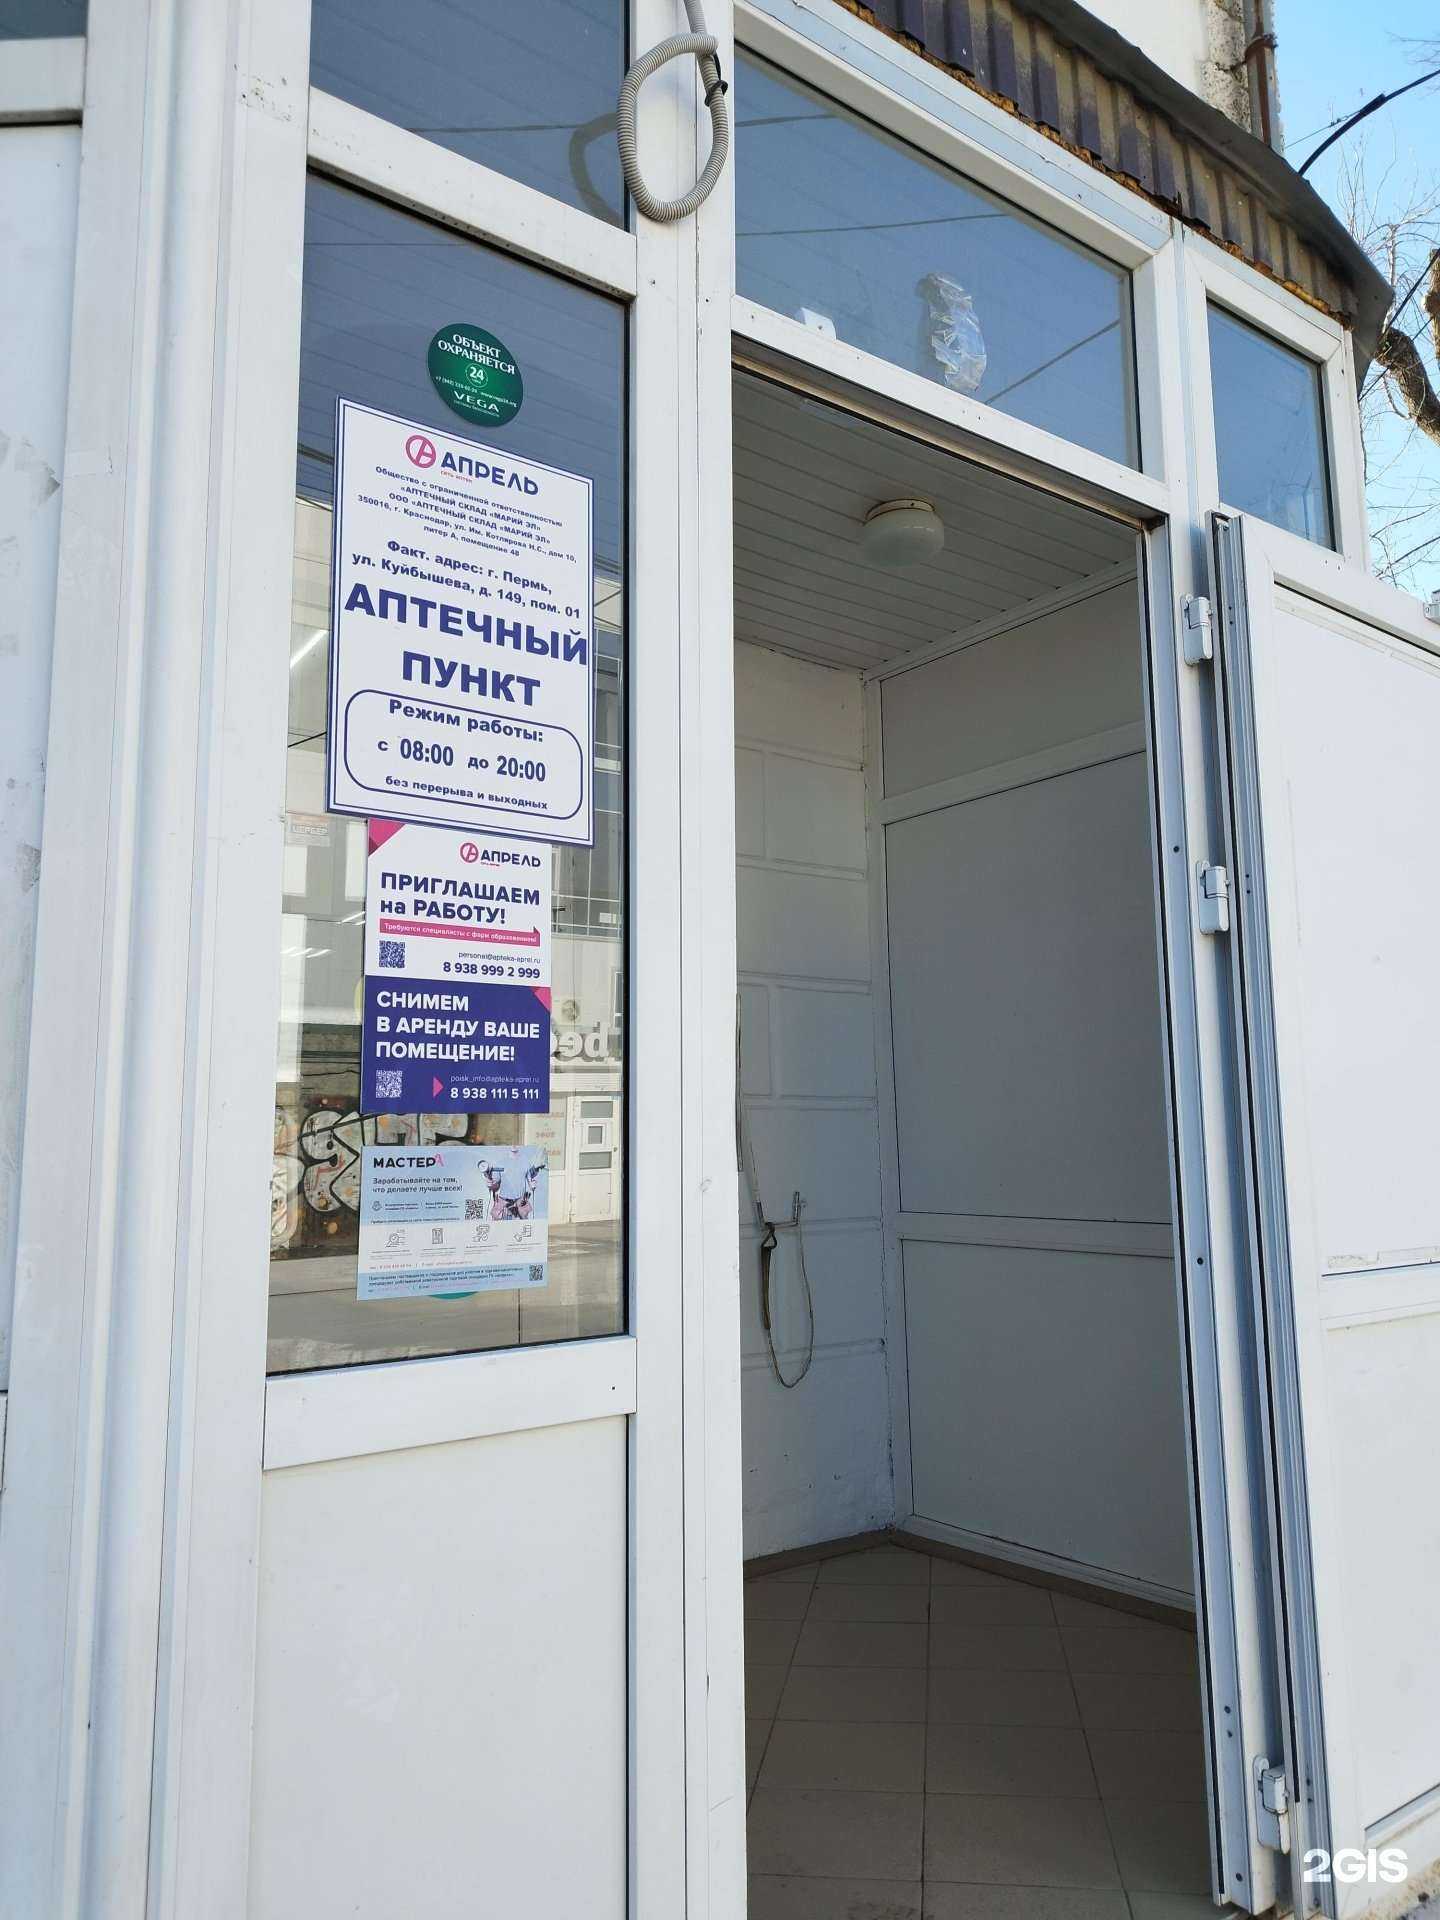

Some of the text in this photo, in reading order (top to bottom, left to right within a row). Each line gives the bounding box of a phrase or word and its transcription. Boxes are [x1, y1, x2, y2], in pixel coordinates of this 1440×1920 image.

[437, 340, 515, 375] ОХРАНЯЕТСЯ
[452, 334, 501, 358] ОБЪЕКТ
[469, 366, 484, 381] 24
[454, 391, 500, 413] VEGA
[441, 452, 539, 495] АПРЕЛЬ
[375, 466, 419, 485] Общество
[429, 483, 489, 505] ограниченной
[492, 500, 563, 527] ответственностью
[401, 485, 455, 506] «АПТЕЧНЫЙ
[458, 500, 487, 516] СКЛАД
[489, 509, 523, 525] «МАРИЙ
[357, 495, 392, 512] 350016,
[403, 507, 452, 528] Краснодар,
[454, 521, 466, 532] ул.
[389, 492, 409, 504] ООО
[411, 497, 466, 519] «АПТЕЧНЫЙ
[469, 514, 497, 530] СКЛАД
[499, 523, 533, 539] «МАРИЙ
[461, 534, 507, 554] помещение
[387, 540, 552, 595] Факт. адрес: г. Пермь,
[351, 552, 580, 618] ул. Куйбышева, д. 149, пом. 01
[344, 582, 587, 665] АПТЕЧНЫЙ
[402, 651, 541, 706] ПУНКТ
[389, 699, 543, 742] Режим работы:
[378, 738, 546, 782] с 08:00 до 20:00
[385, 775, 548, 809] без перерыва и выходных
[481, 849, 541, 868] АПРЕЛЬ
[381, 872, 539, 905] ПРИГЛАШАЕМ
[381, 900, 505, 924] на РАБОТУ!
[443, 962, 540, 979] 8 938 999 2 999
[377, 991, 469, 1011] СНИМЕМ
[377, 1017, 540, 1038] В АРЕНДУ ВАШЕ
[376, 1042, 515, 1061] ПОМЕЩЕНИЕ!
[450, 1088, 538, 1099] 8 938 111 5 111
[373, 1177, 430, 1185] Зарабатывайте
